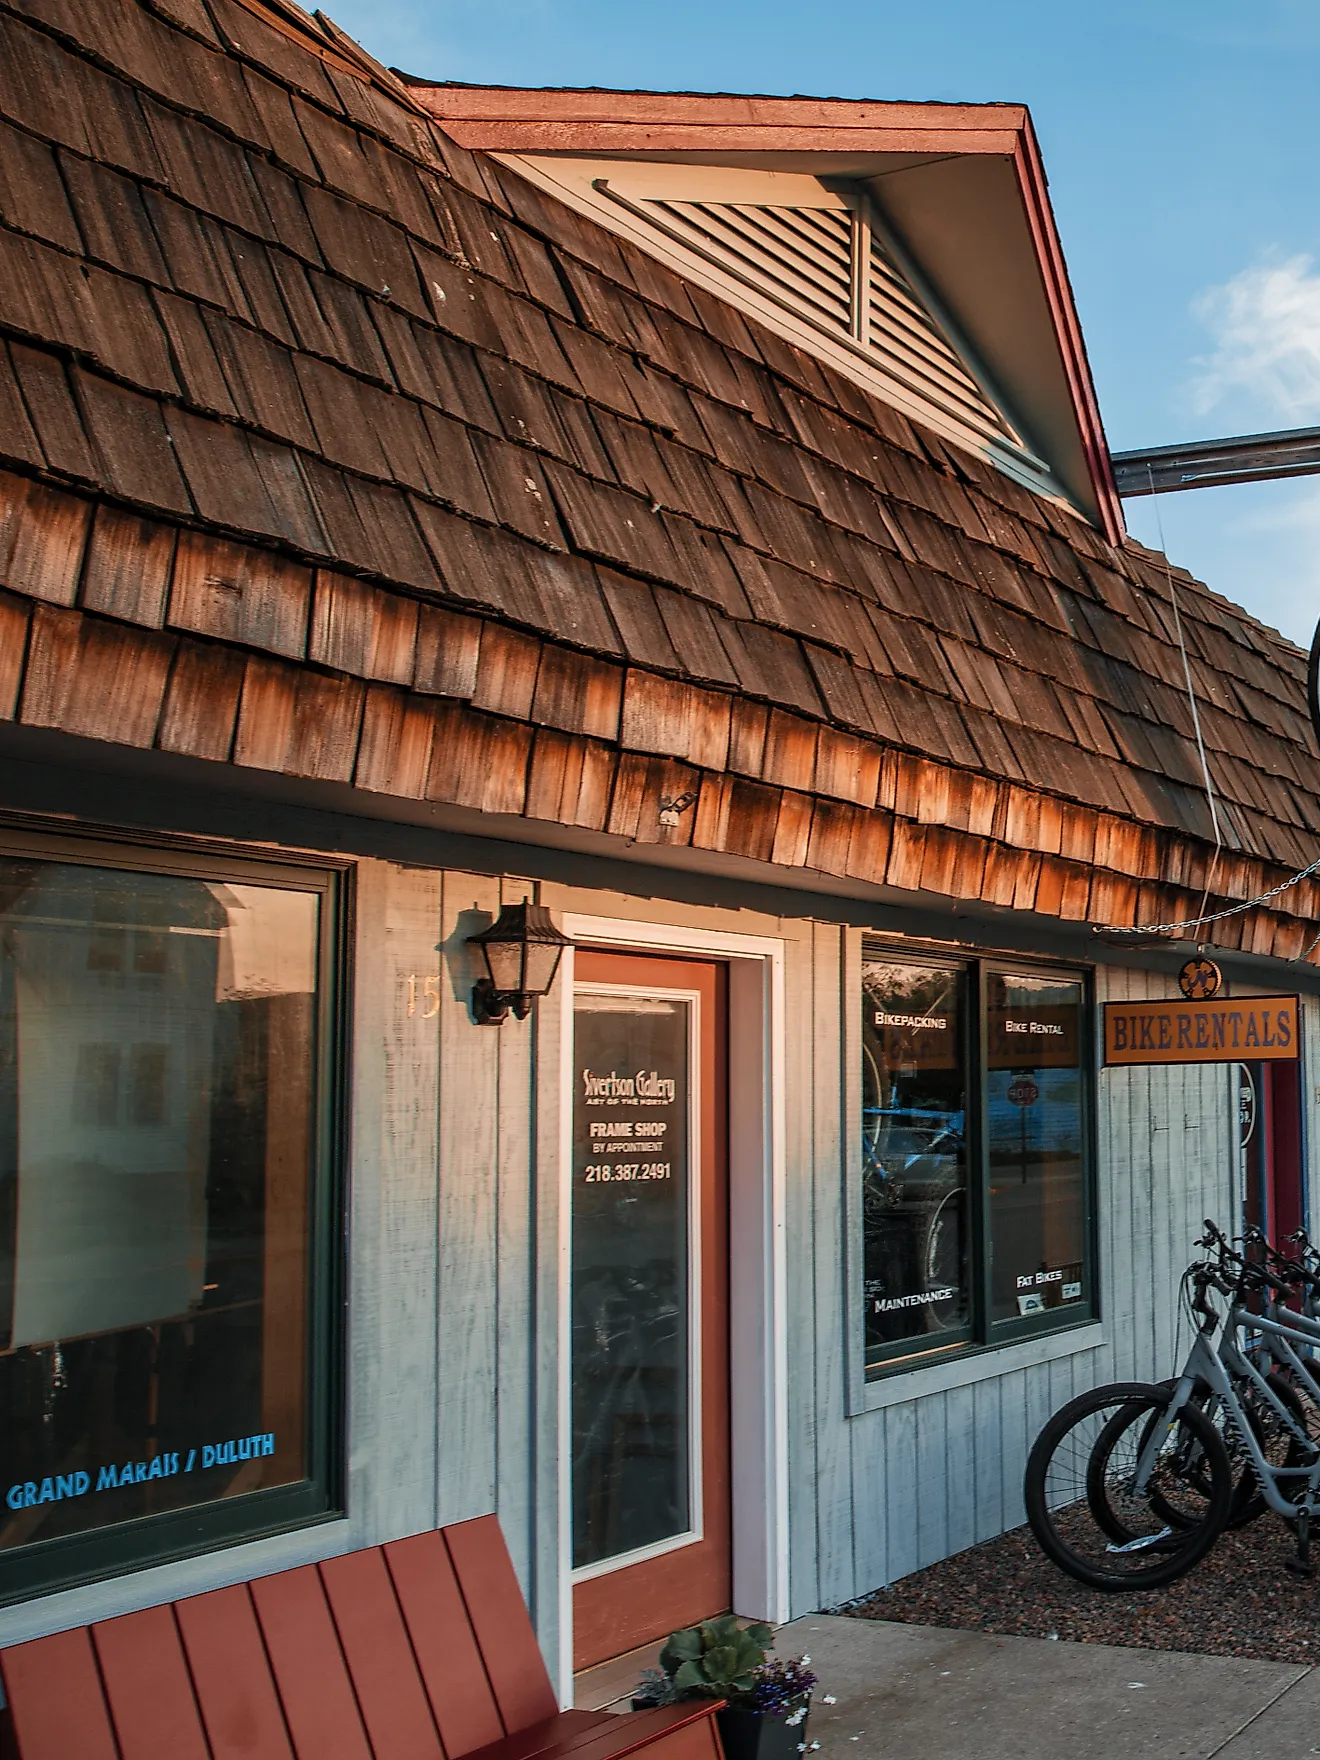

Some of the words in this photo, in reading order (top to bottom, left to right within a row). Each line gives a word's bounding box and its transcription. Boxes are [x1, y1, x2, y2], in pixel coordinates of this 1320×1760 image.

[874, 1011, 947, 1029] BIKEPACKING
[1005, 1020, 1028, 1033] BIKE
[1029, 1022, 1064, 1035] RENTAL
[1113, 1015, 1172, 1050] BIKE
[1176, 1010, 1291, 1049] RENTALS
[583, 1069, 634, 1096] Sivertson
[636, 1069, 675, 1103] Gallery
[590, 1122, 633, 1137] FRAME
[634, 1122, 667, 1136] SHOP
[592, 1143, 605, 1154] BY
[606, 1141, 664, 1153] APPOINTMENT
[585, 1162, 671, 1182] 218.387.2491
[1016, 1276, 1034, 1288] FAT
[1036, 1270, 1062, 1284] BIKES
[874, 1289, 953, 1313] MAINTENANCE
[6, 1470, 90, 1510] GRAND
[96, 1452, 180, 1492] MARAIS
[184, 1449, 197, 1473] /
[202, 1433, 275, 1469] DULUTH
